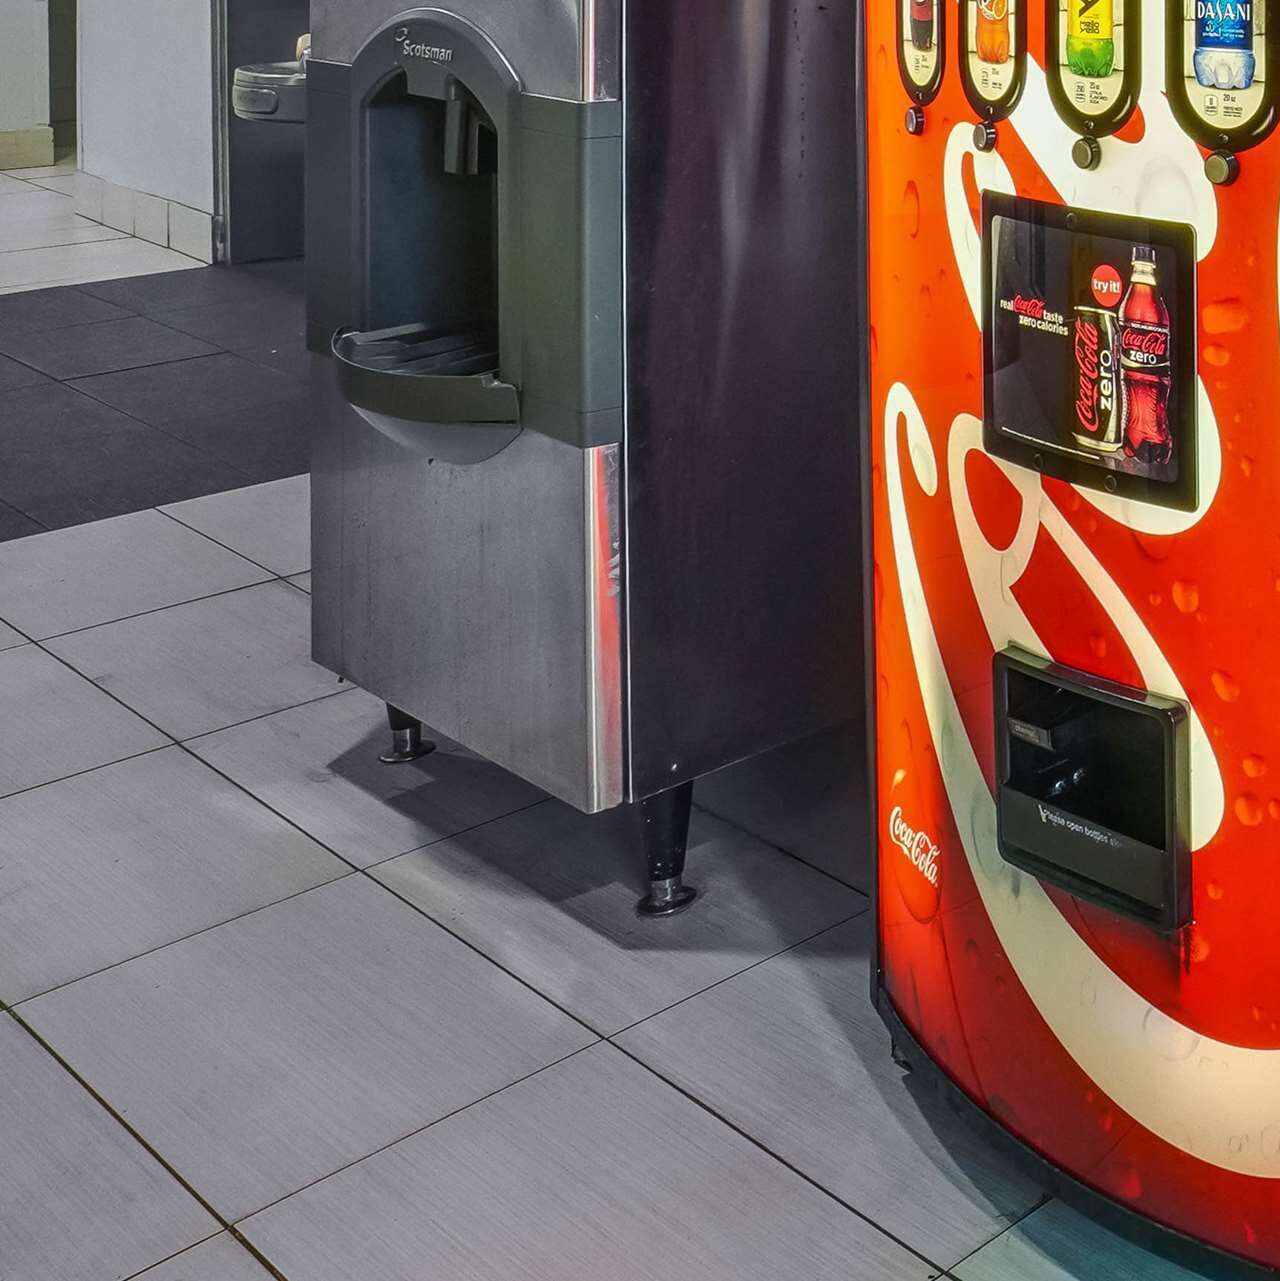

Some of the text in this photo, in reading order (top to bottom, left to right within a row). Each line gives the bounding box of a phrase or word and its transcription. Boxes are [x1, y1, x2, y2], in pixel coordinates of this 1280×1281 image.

[1197, 0, 1250, 23] DASANI
[403, 40, 452, 61] Scotsman
[1093, 279, 1120, 293] try it!
[1000, 299, 1014, 309] real
[1043, 309, 1064, 323] taste
[1019, 315, 1069, 336] zero calories
[1129, 350, 1156, 364] zero
[1100, 350, 1112, 411] zero
